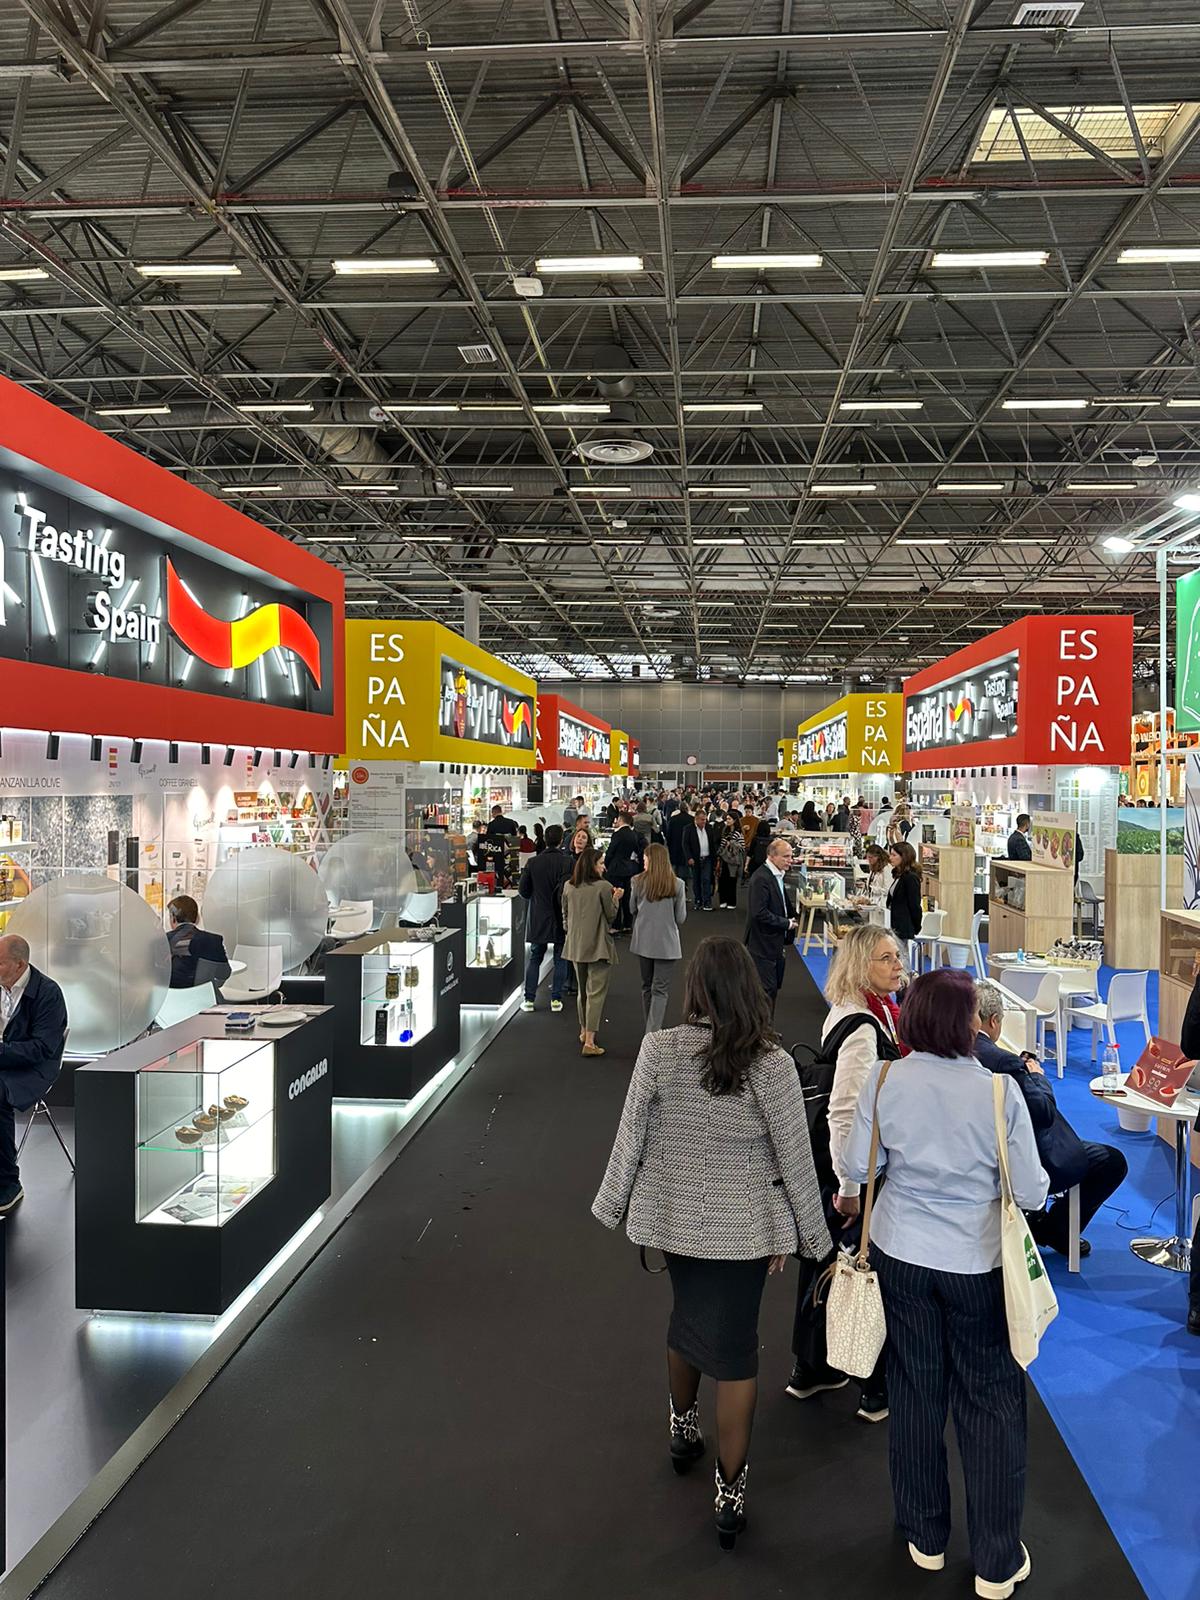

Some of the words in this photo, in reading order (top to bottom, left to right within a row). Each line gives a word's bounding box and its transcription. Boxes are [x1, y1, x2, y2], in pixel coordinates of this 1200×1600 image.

[24, 504, 125, 589] Tasting
[93, 590, 161, 644] Spain
[370, 633, 404, 662] ES
[1060, 630, 1098, 661] ES
[368, 676, 406, 705] PA
[1057, 675, 1100, 706] PA
[866, 701, 887, 718] ES
[906, 697, 944, 751] España
[362, 712, 410, 748] ÑA
[864, 725, 888, 742] PA
[1050, 714, 1105, 752] ÑA
[861, 746, 891, 766] ÑA
[0, 777, 40, 788] ANZANILLA
[41, 777, 61, 788] OLIVE
[288, 1058, 328, 1100] CONGALSA
